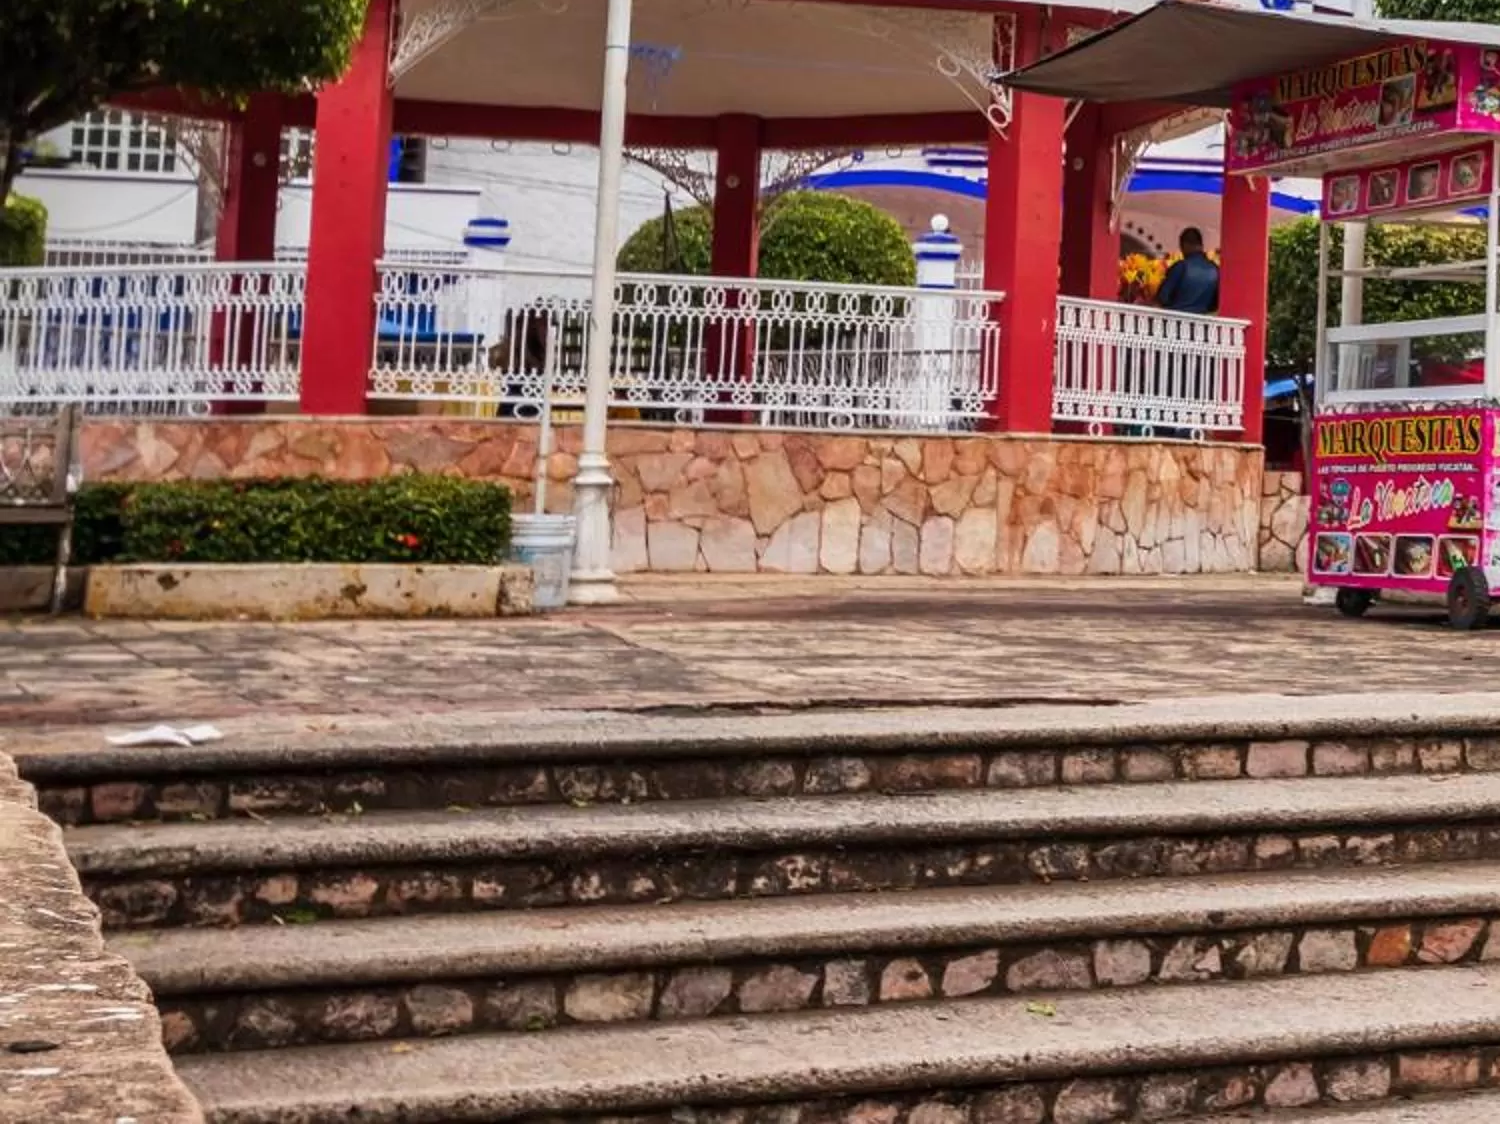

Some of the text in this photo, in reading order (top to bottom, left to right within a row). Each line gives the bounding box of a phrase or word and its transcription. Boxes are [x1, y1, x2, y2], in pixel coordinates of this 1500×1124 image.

[1277, 41, 1428, 103] MARQUESITAS
[1316, 415, 1482, 463] MARQUESITAS
[1346, 486, 1374, 531] La
